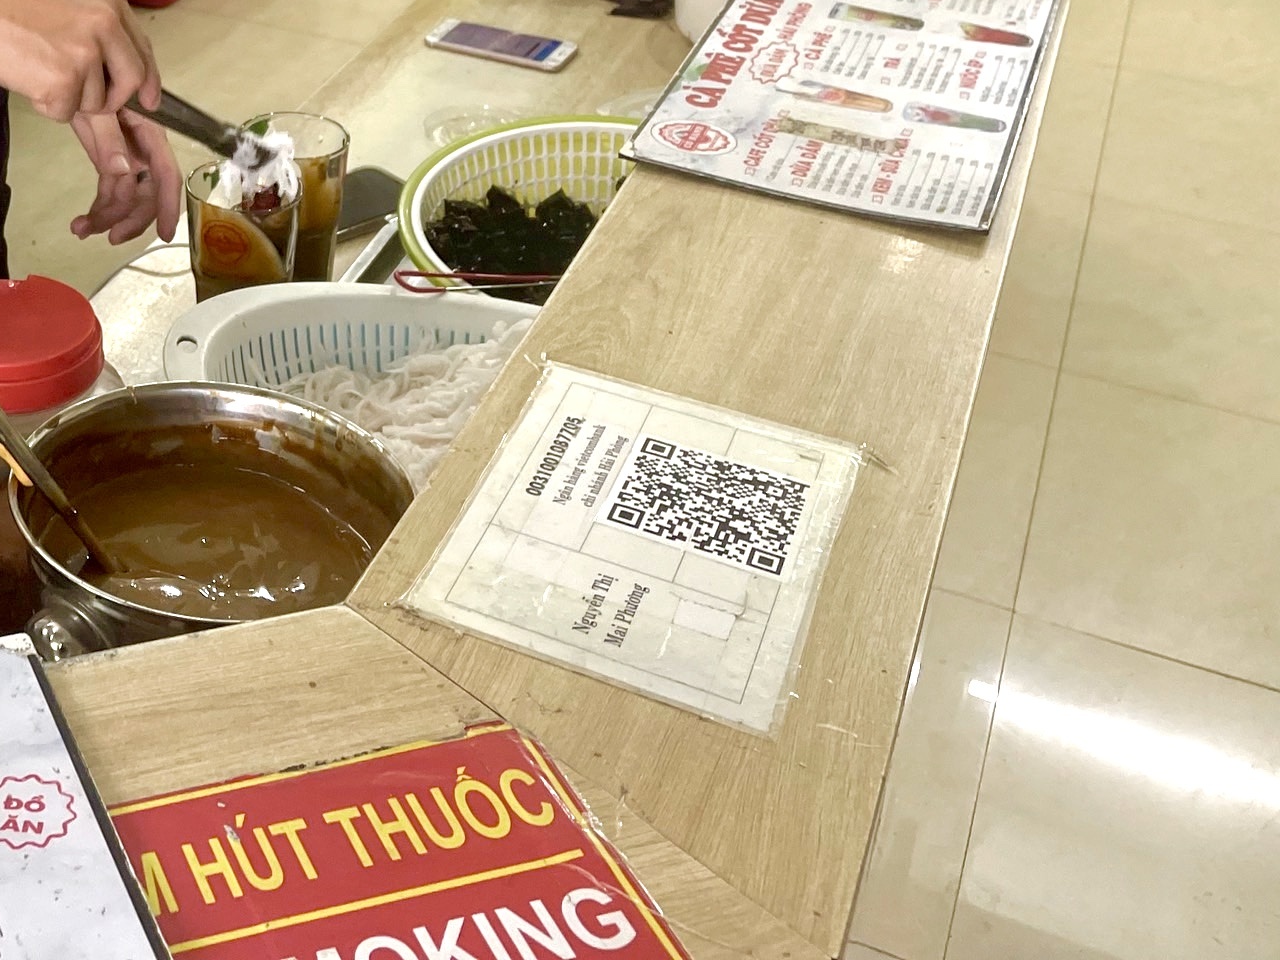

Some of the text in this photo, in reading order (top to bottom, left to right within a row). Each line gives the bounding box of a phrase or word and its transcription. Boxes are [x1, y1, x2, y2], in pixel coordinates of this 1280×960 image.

[700, 52, 746, 85] PHÊ
[716, 24, 764, 53] CỐT
[682, 85, 726, 108] CÀ
[525, 416, 581, 497] 0031001087705
[552, 424, 606, 506] Ngân hàng vietcombank
[581, 435, 629, 508] chi nhánh Hải Phòng
[572, 573, 619, 635] Nguyễn Thị
[604, 583, 650, 648] Mai Phương
[0, 816, 45, 835] ĂN
[182, 813, 319, 904] HÚT
[322, 766, 556, 868] THUỐC
